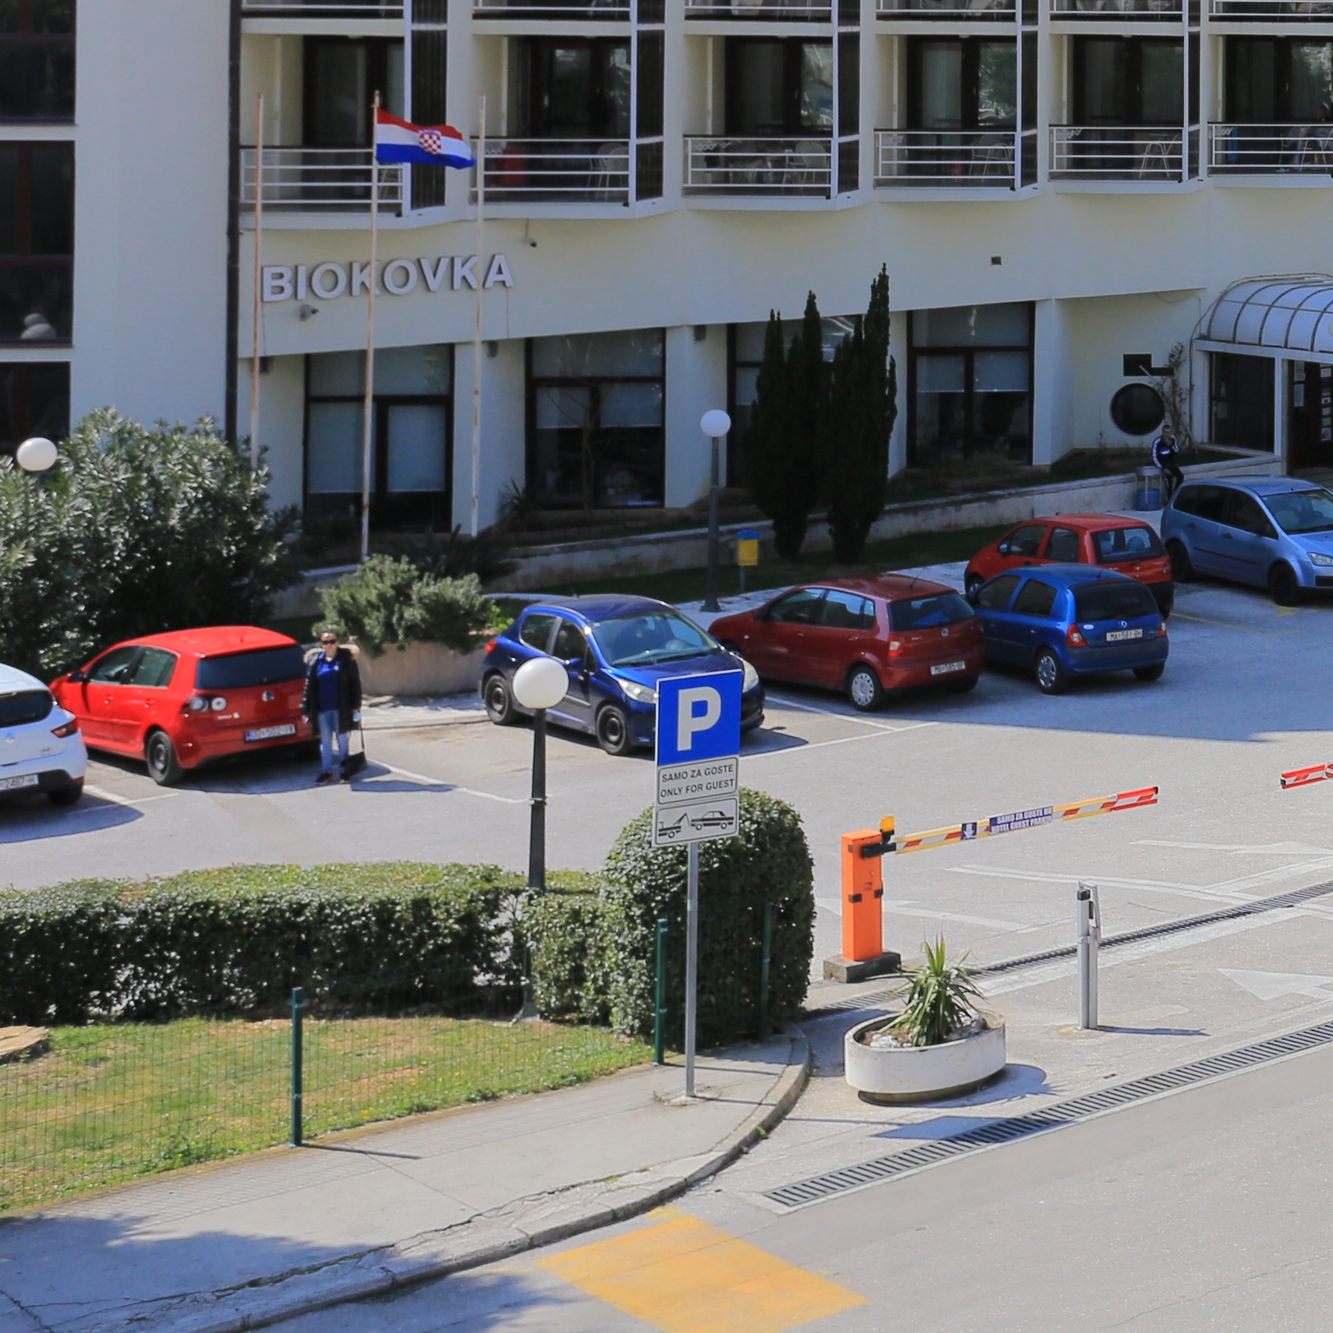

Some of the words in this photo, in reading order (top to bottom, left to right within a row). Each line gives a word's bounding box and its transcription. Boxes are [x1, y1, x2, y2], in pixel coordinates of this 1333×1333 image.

[262, 254, 514, 302] BIOKOVKA
[677, 686, 721, 751] P
[662, 771, 688, 782] SAMO
[691, 769, 701, 778] ZA
[704, 764, 734, 776] GOSTE
[660, 787, 683, 797] ONLY
[686, 784, 703, 794] FOR
[706, 779, 734, 790] GUEST
[997, 814, 1014, 824] SAMO
[1016, 812, 1023, 820] ZA
[1024, 808, 1043, 818] GOSTE
[991, 823, 1009, 833] HOTEL
[1010, 819, 1030, 830] GUEST
